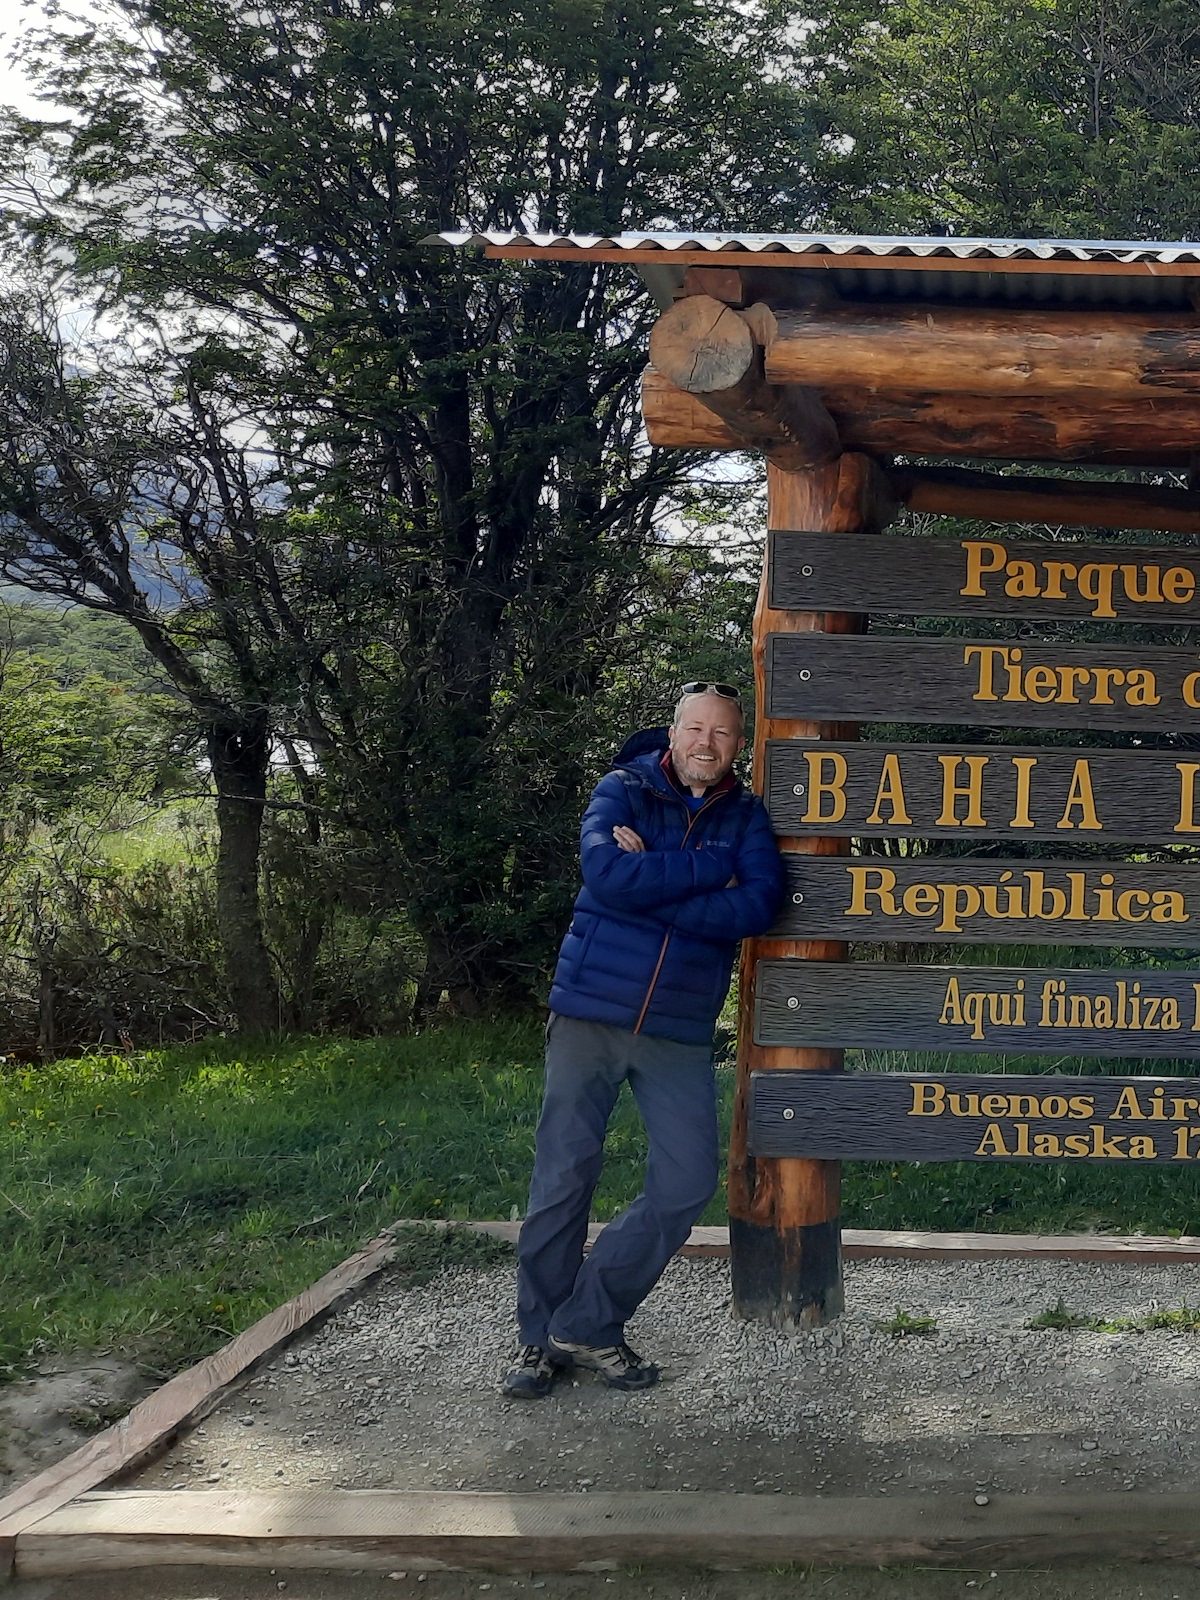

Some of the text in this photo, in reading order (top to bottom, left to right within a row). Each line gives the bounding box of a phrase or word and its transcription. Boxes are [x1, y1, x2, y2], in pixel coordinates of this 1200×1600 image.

[959, 541, 1196, 618] Parque
[963, 645, 1161, 706] Tierra
[801, 751, 1103, 830] BAHIA
[845, 866, 1190, 933] República
[938, 976, 1027, 1039] Aqui
[1038, 979, 1181, 1030] finaliza
[907, 1082, 1095, 1119] Buenos
[974, 1123, 1157, 1159] Alaska
